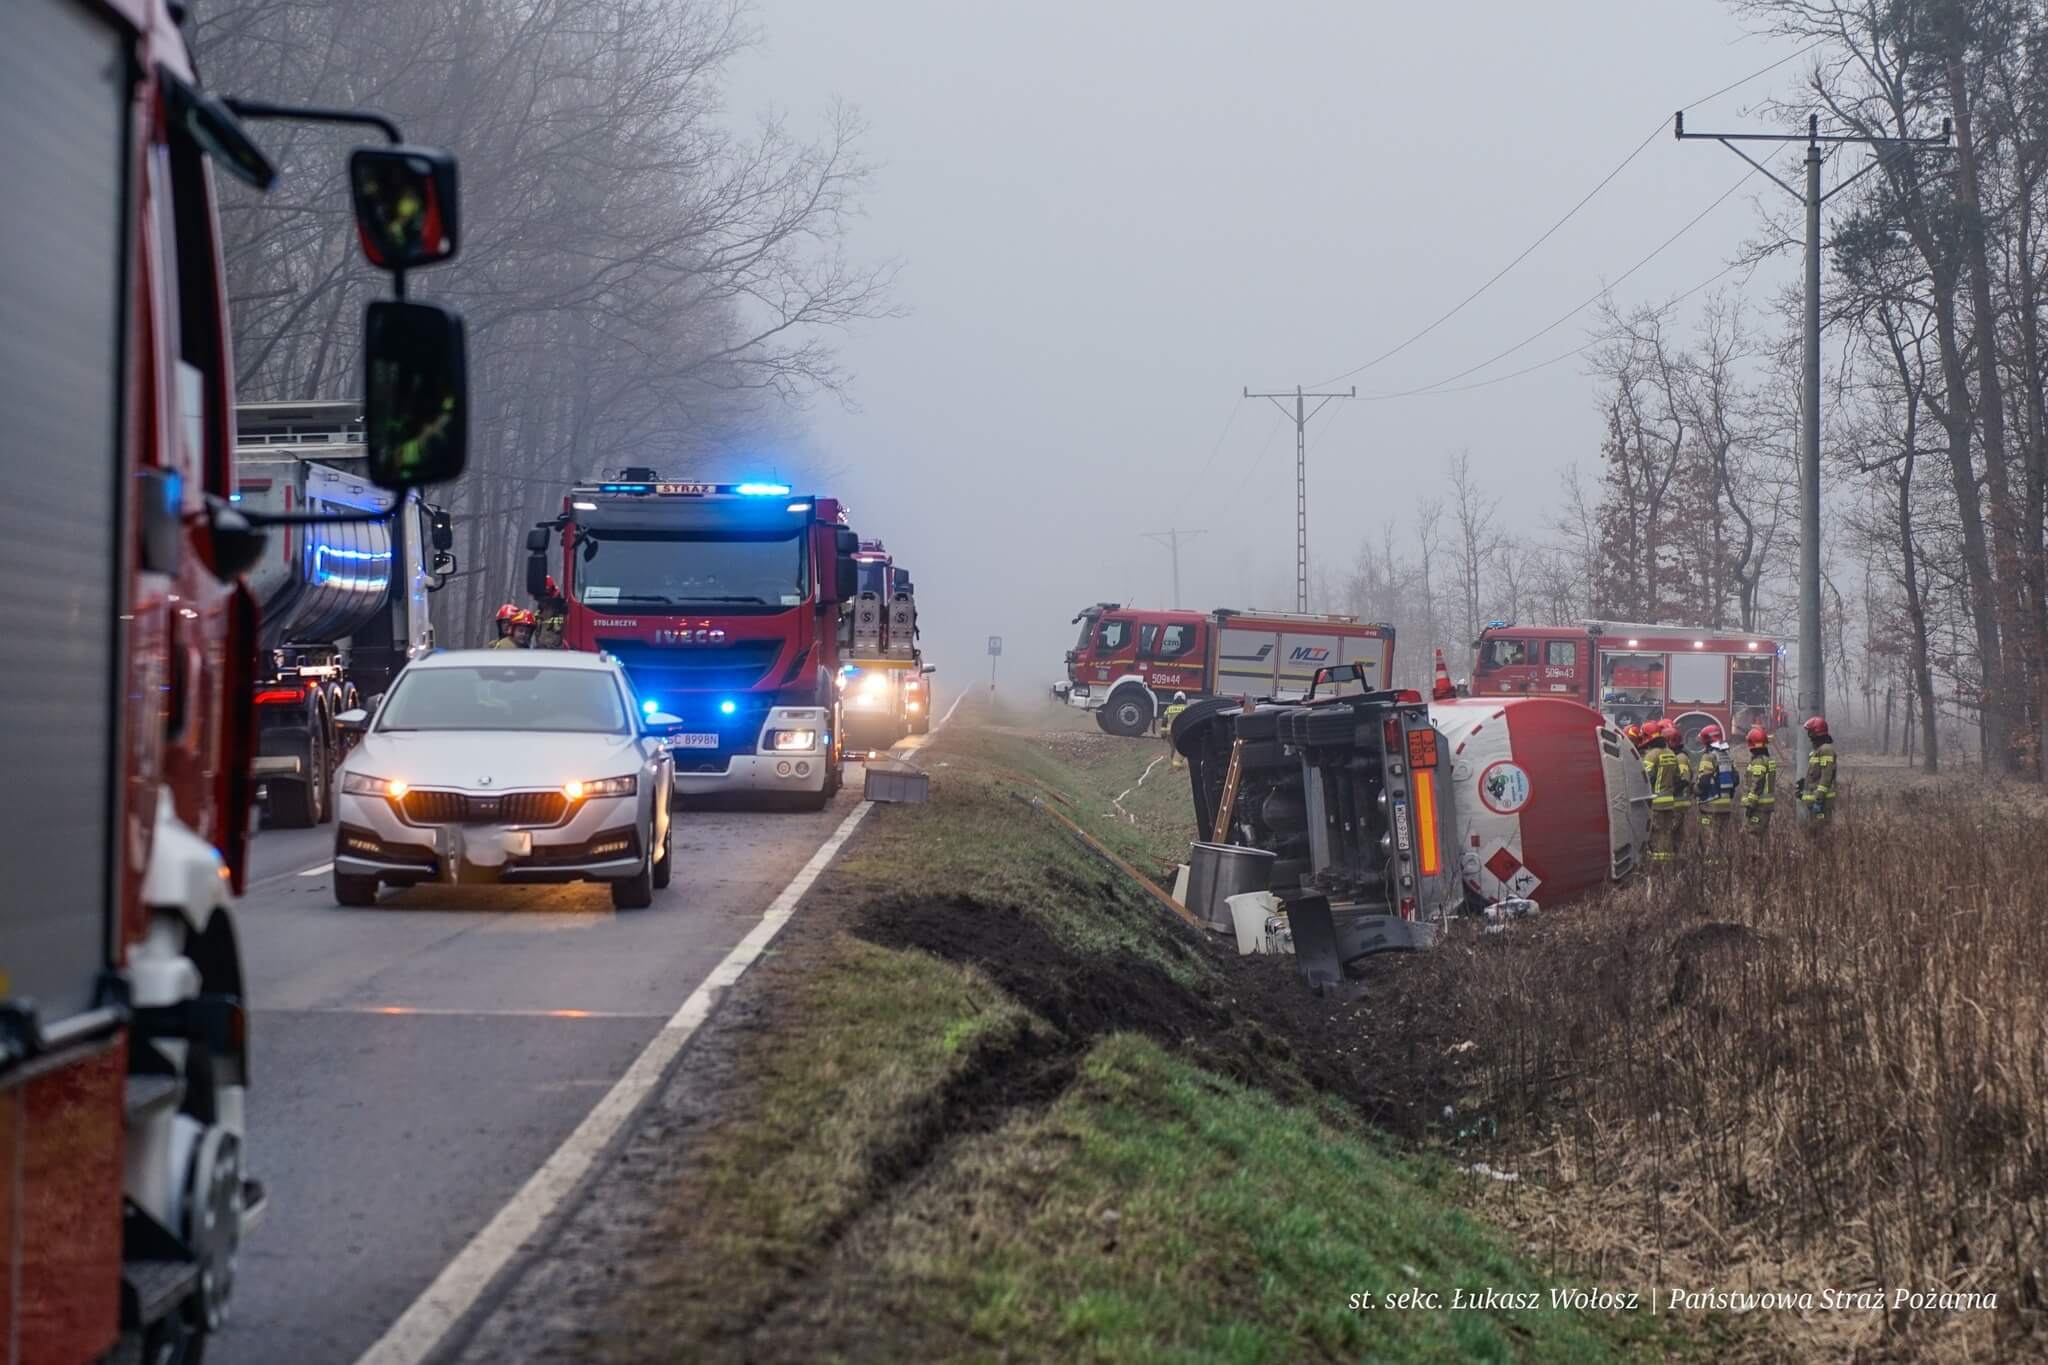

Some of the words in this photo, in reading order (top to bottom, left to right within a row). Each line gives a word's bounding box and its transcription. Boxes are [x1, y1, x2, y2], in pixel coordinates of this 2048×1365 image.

[593, 619, 638, 627] STOLARCZYK
[655, 629, 726, 644] IVECO
[685, 734, 717, 745] 8998N
